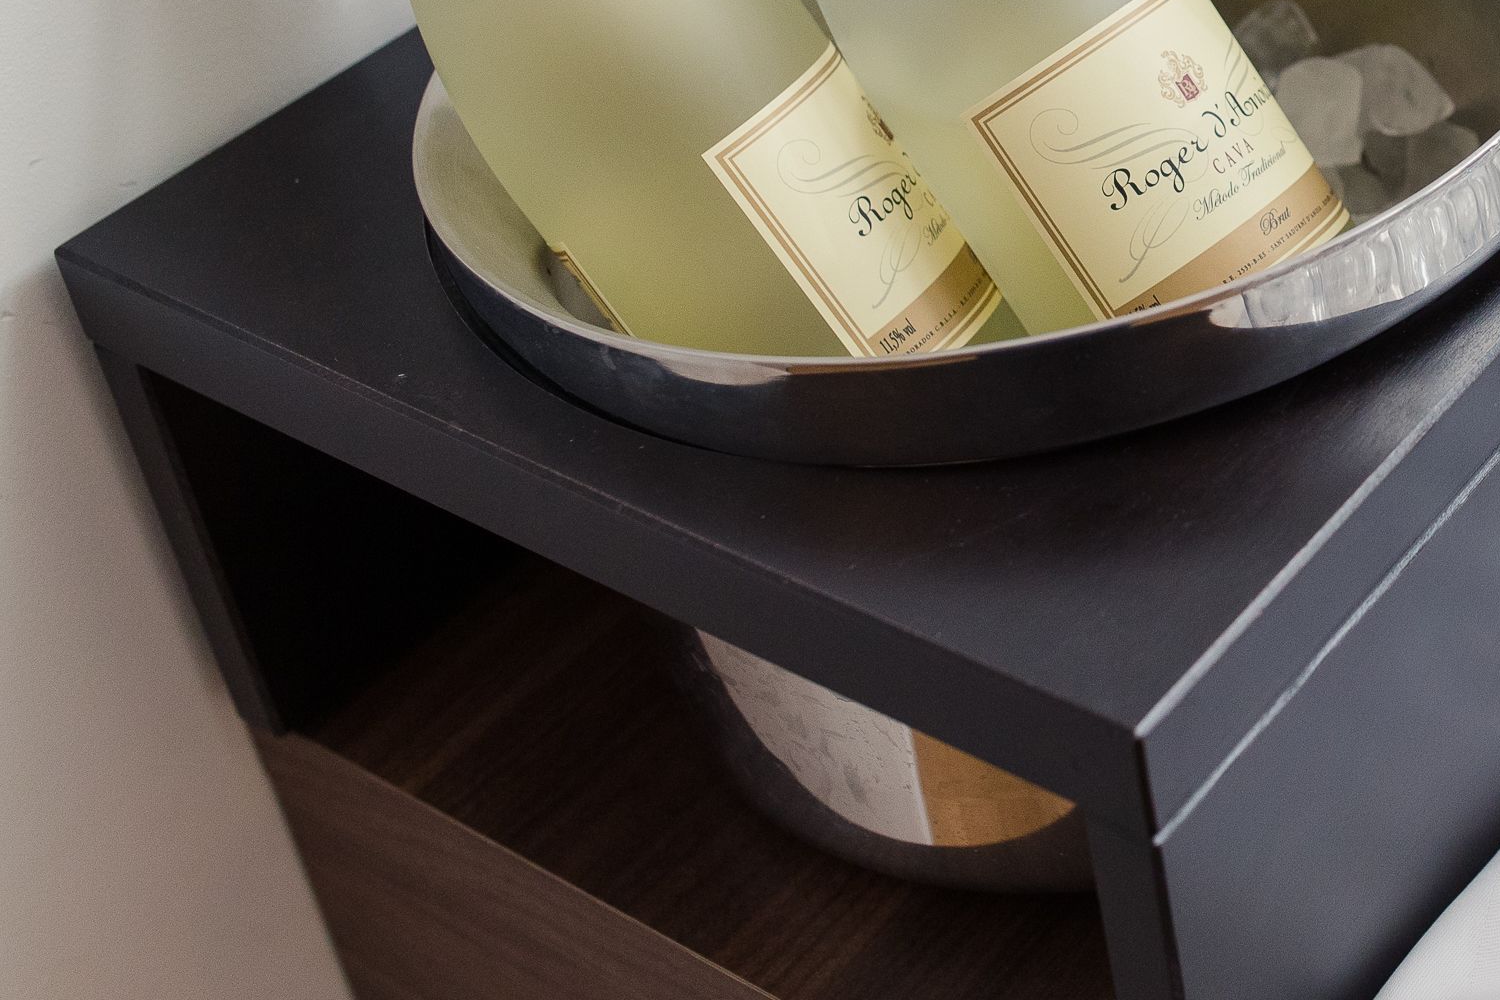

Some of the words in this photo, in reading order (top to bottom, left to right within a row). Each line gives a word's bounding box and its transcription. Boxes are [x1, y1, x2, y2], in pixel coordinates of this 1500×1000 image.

[1101, 135, 1209, 211] Roger
[1193, 181, 1240, 221] Método
[1239, 141, 1287, 187] Tradicional
[1213, 138, 1254, 174] CAVA
[848, 170, 917, 236] Roger
[1260, 207, 1291, 236] Brut
[879, 327, 906, 355] 11,5%
[902, 317, 917, 337] vol
